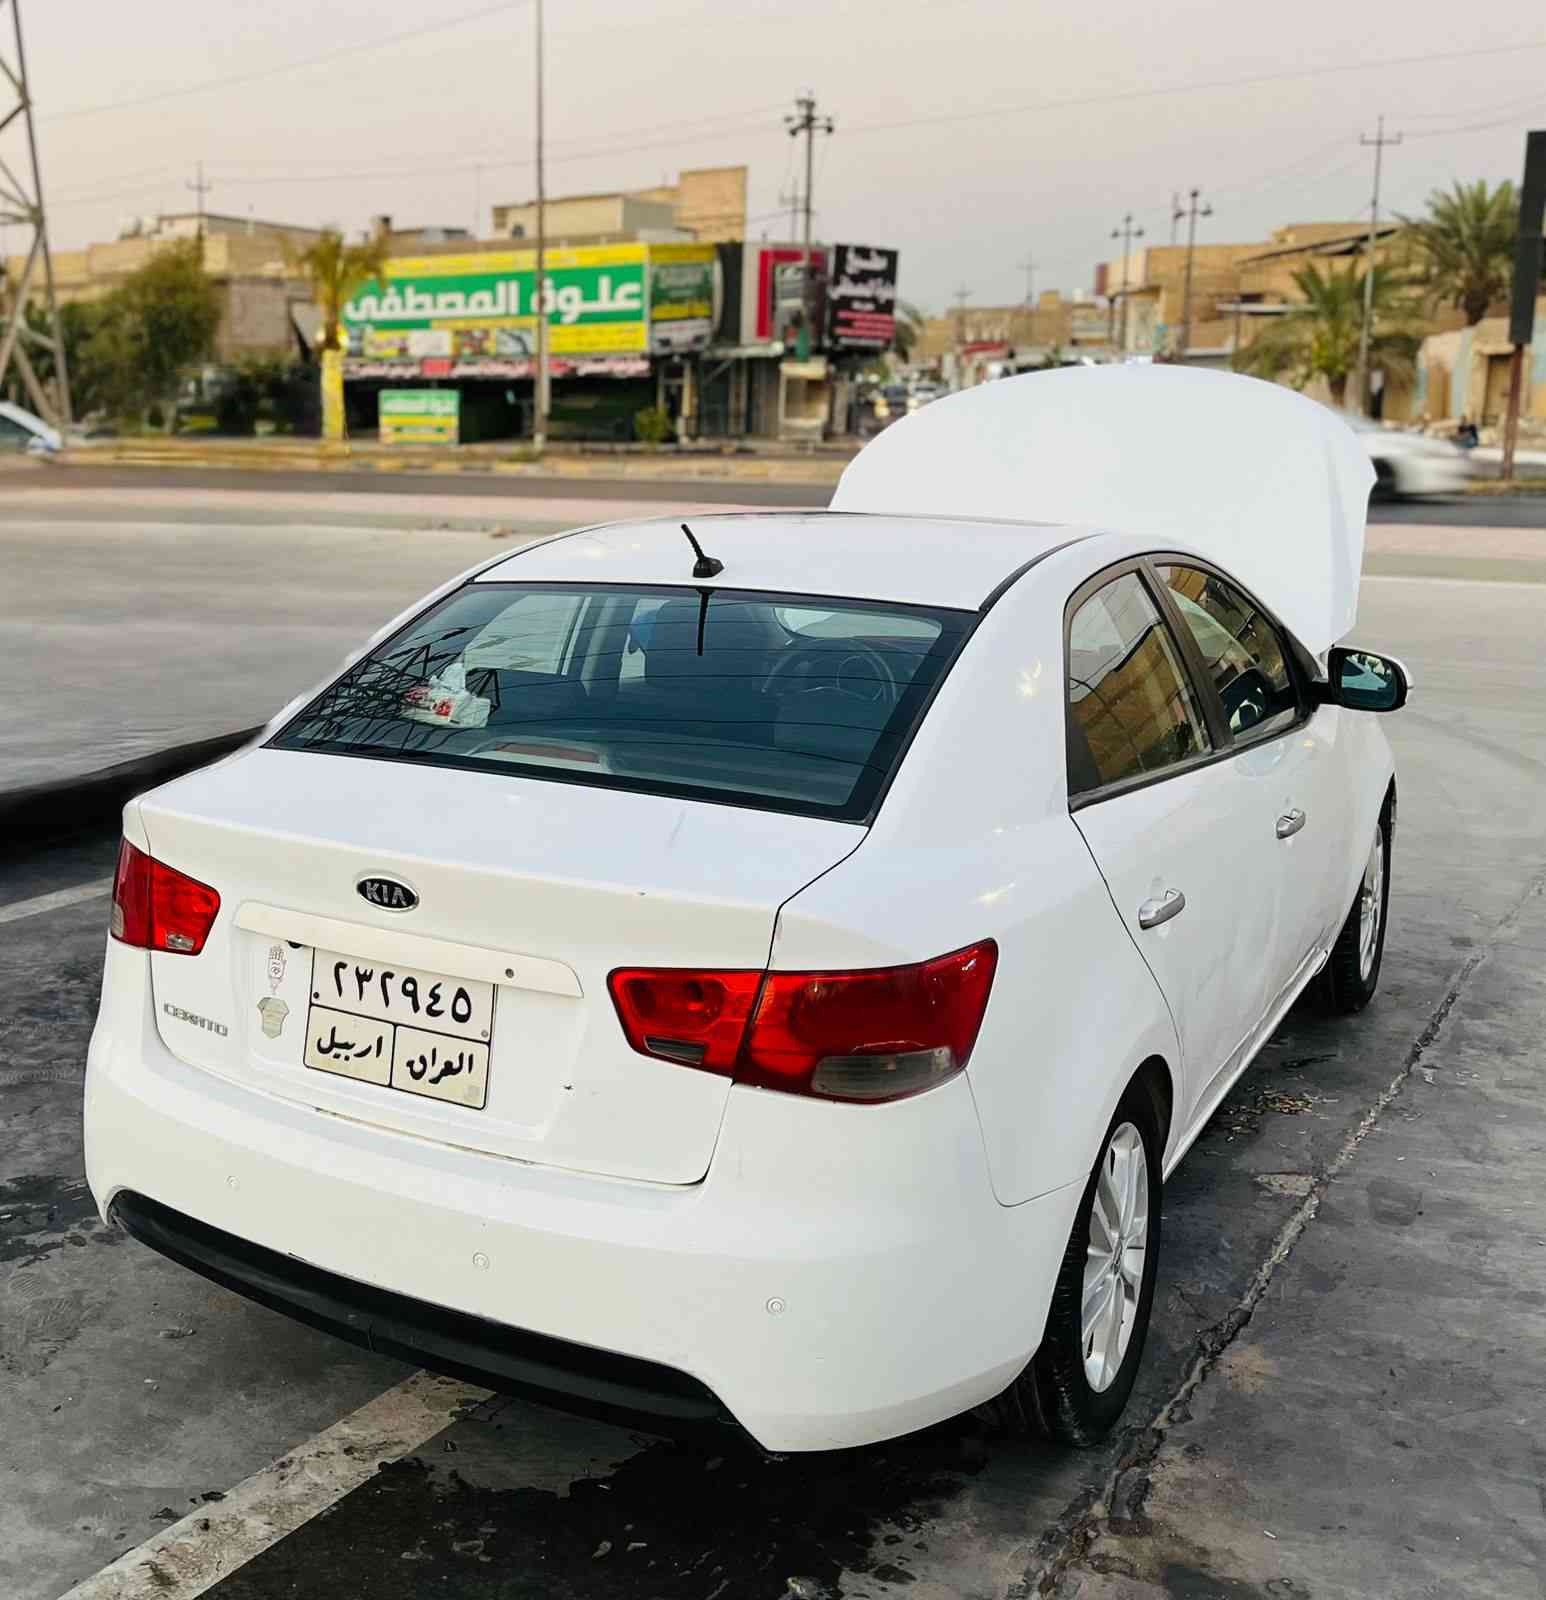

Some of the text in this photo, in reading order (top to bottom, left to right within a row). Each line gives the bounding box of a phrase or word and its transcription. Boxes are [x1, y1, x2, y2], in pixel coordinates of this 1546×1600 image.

[366, 881, 408, 907] KIA
[333, 961, 472, 1024] ٢٣٢٩٤٥
[163, 1003, 229, 1037] CERATO
[316, 1026, 384, 1061] اربيل
[406, 1047, 475, 1085] العراق
